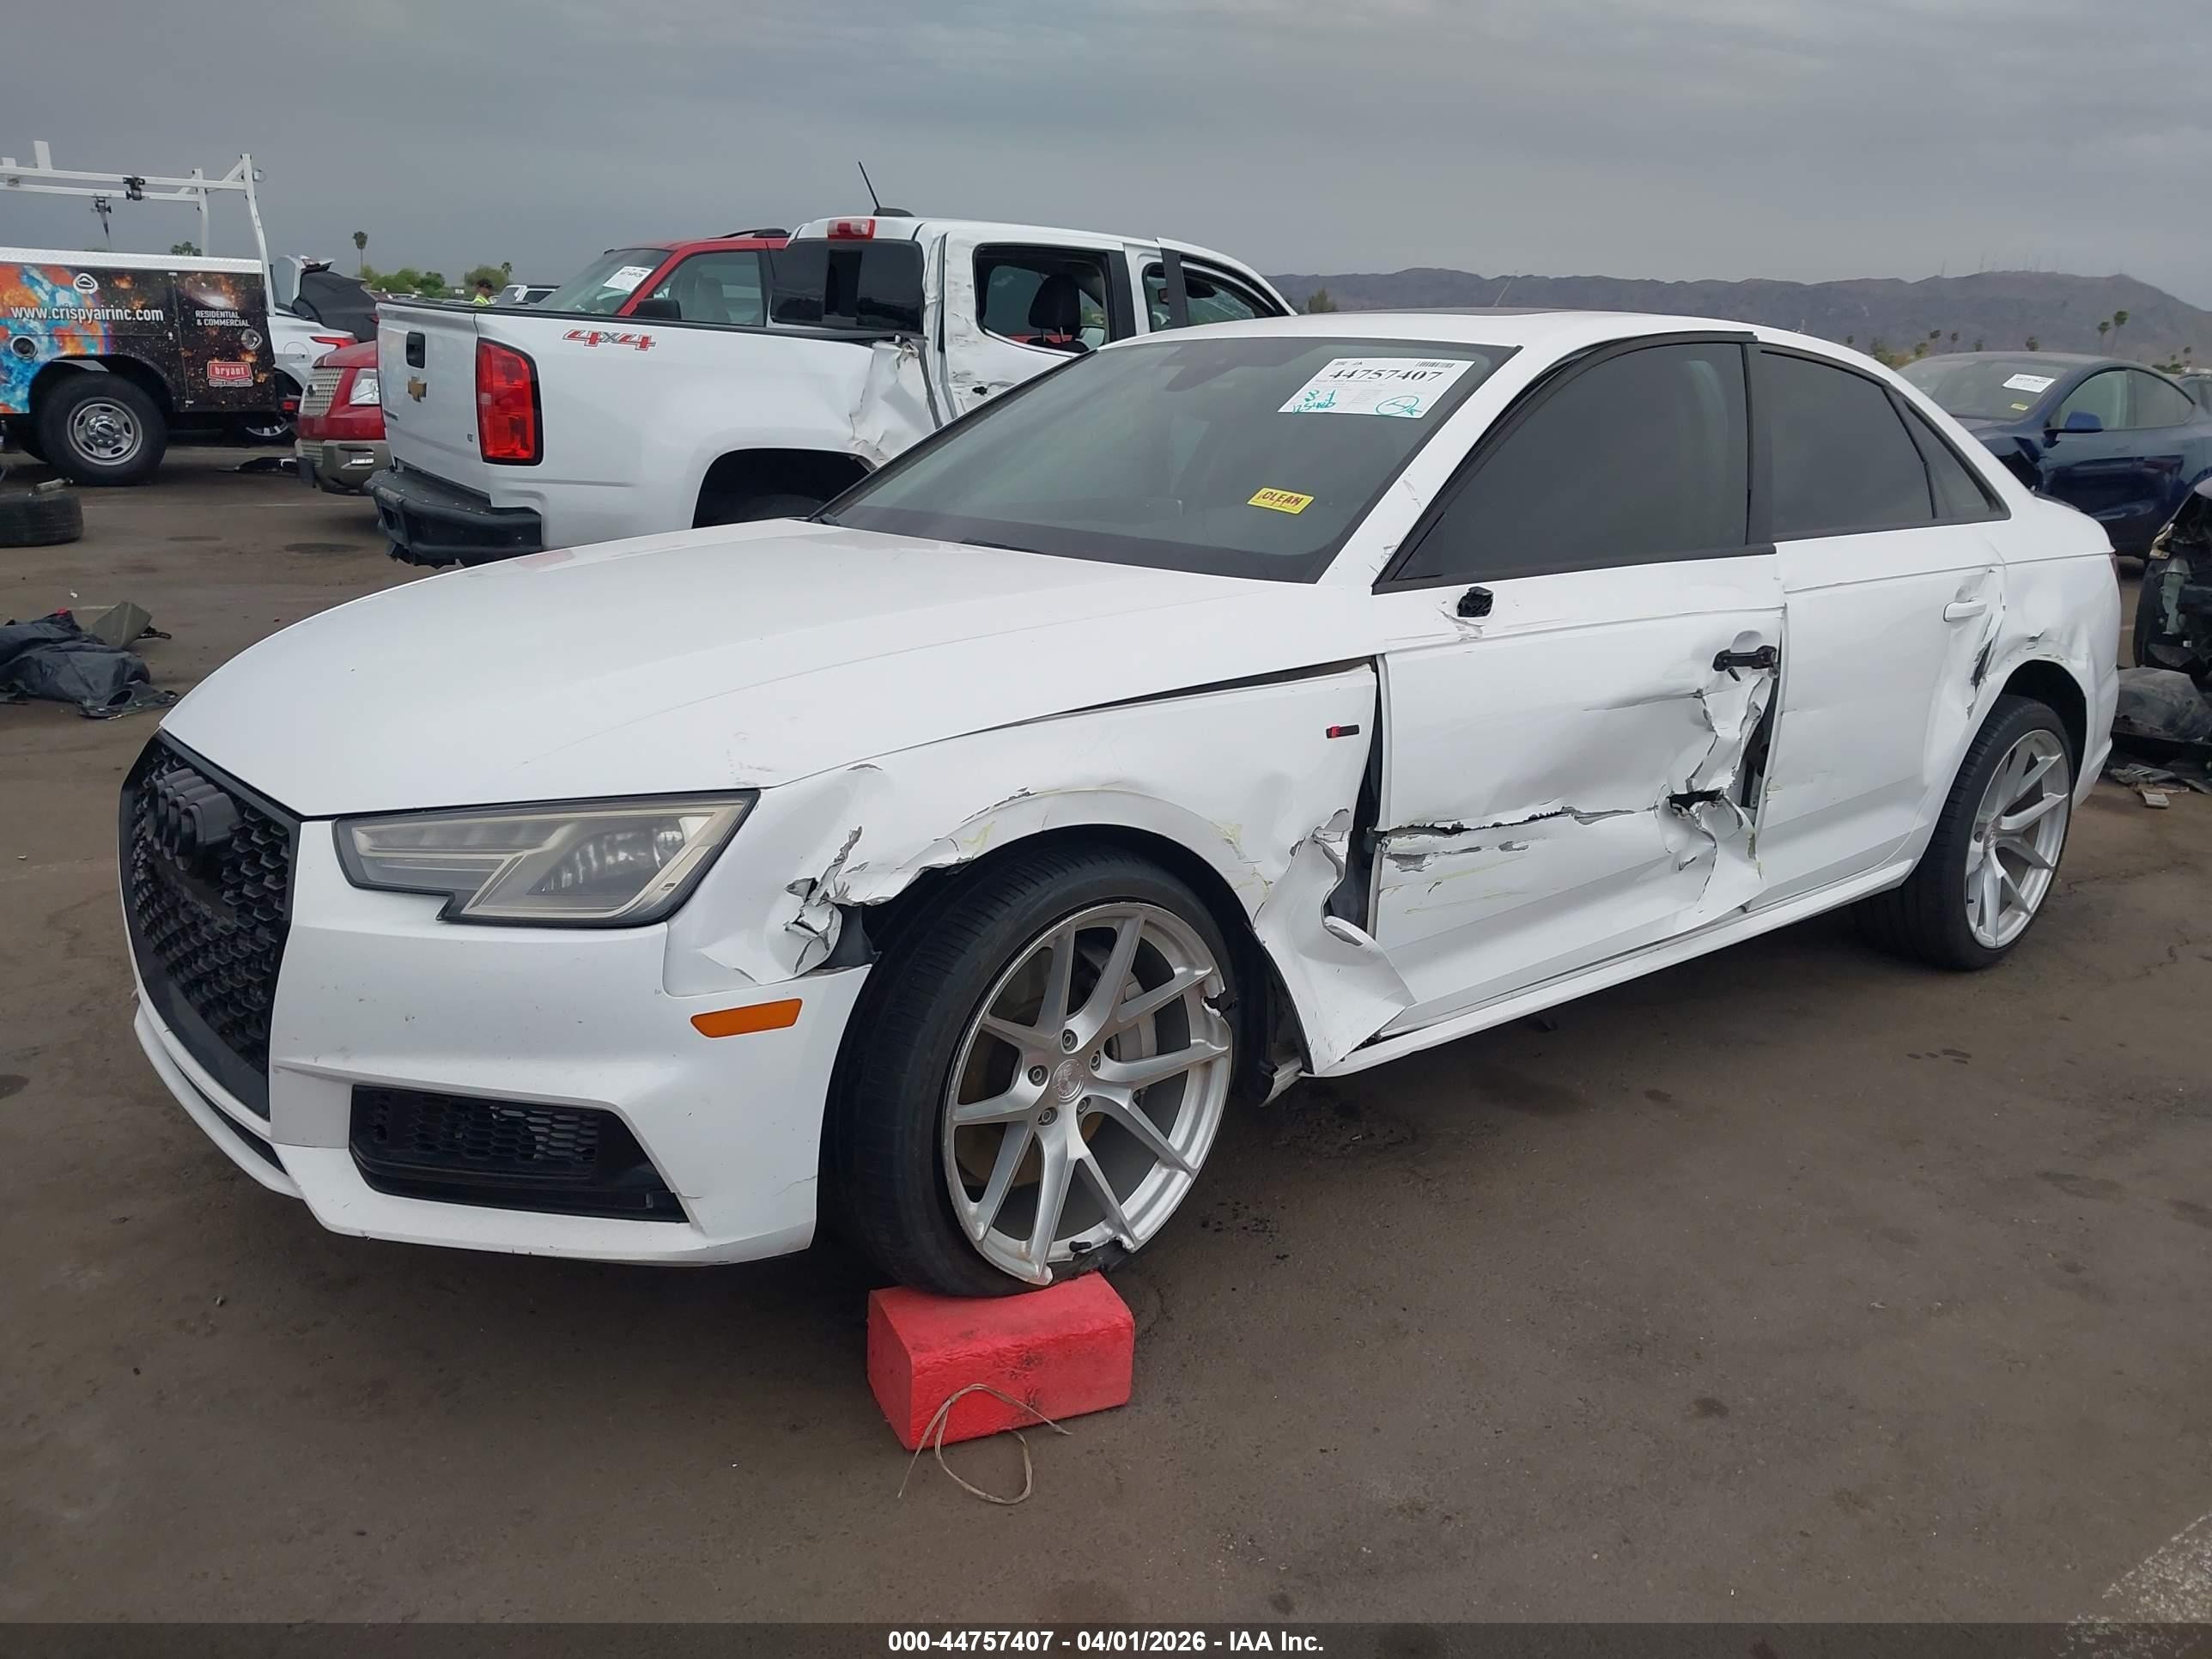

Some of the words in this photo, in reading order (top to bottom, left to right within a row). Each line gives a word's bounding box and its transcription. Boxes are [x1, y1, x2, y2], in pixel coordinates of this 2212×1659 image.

[10, 304, 164, 324] www.crispyairinc.com
[195, 309, 240, 319] RESIDENTIAL
[204, 319, 250, 327] COMMERCIAL
[215, 367, 245, 376] bryant
[1329, 369, 1443, 381] 44757407
